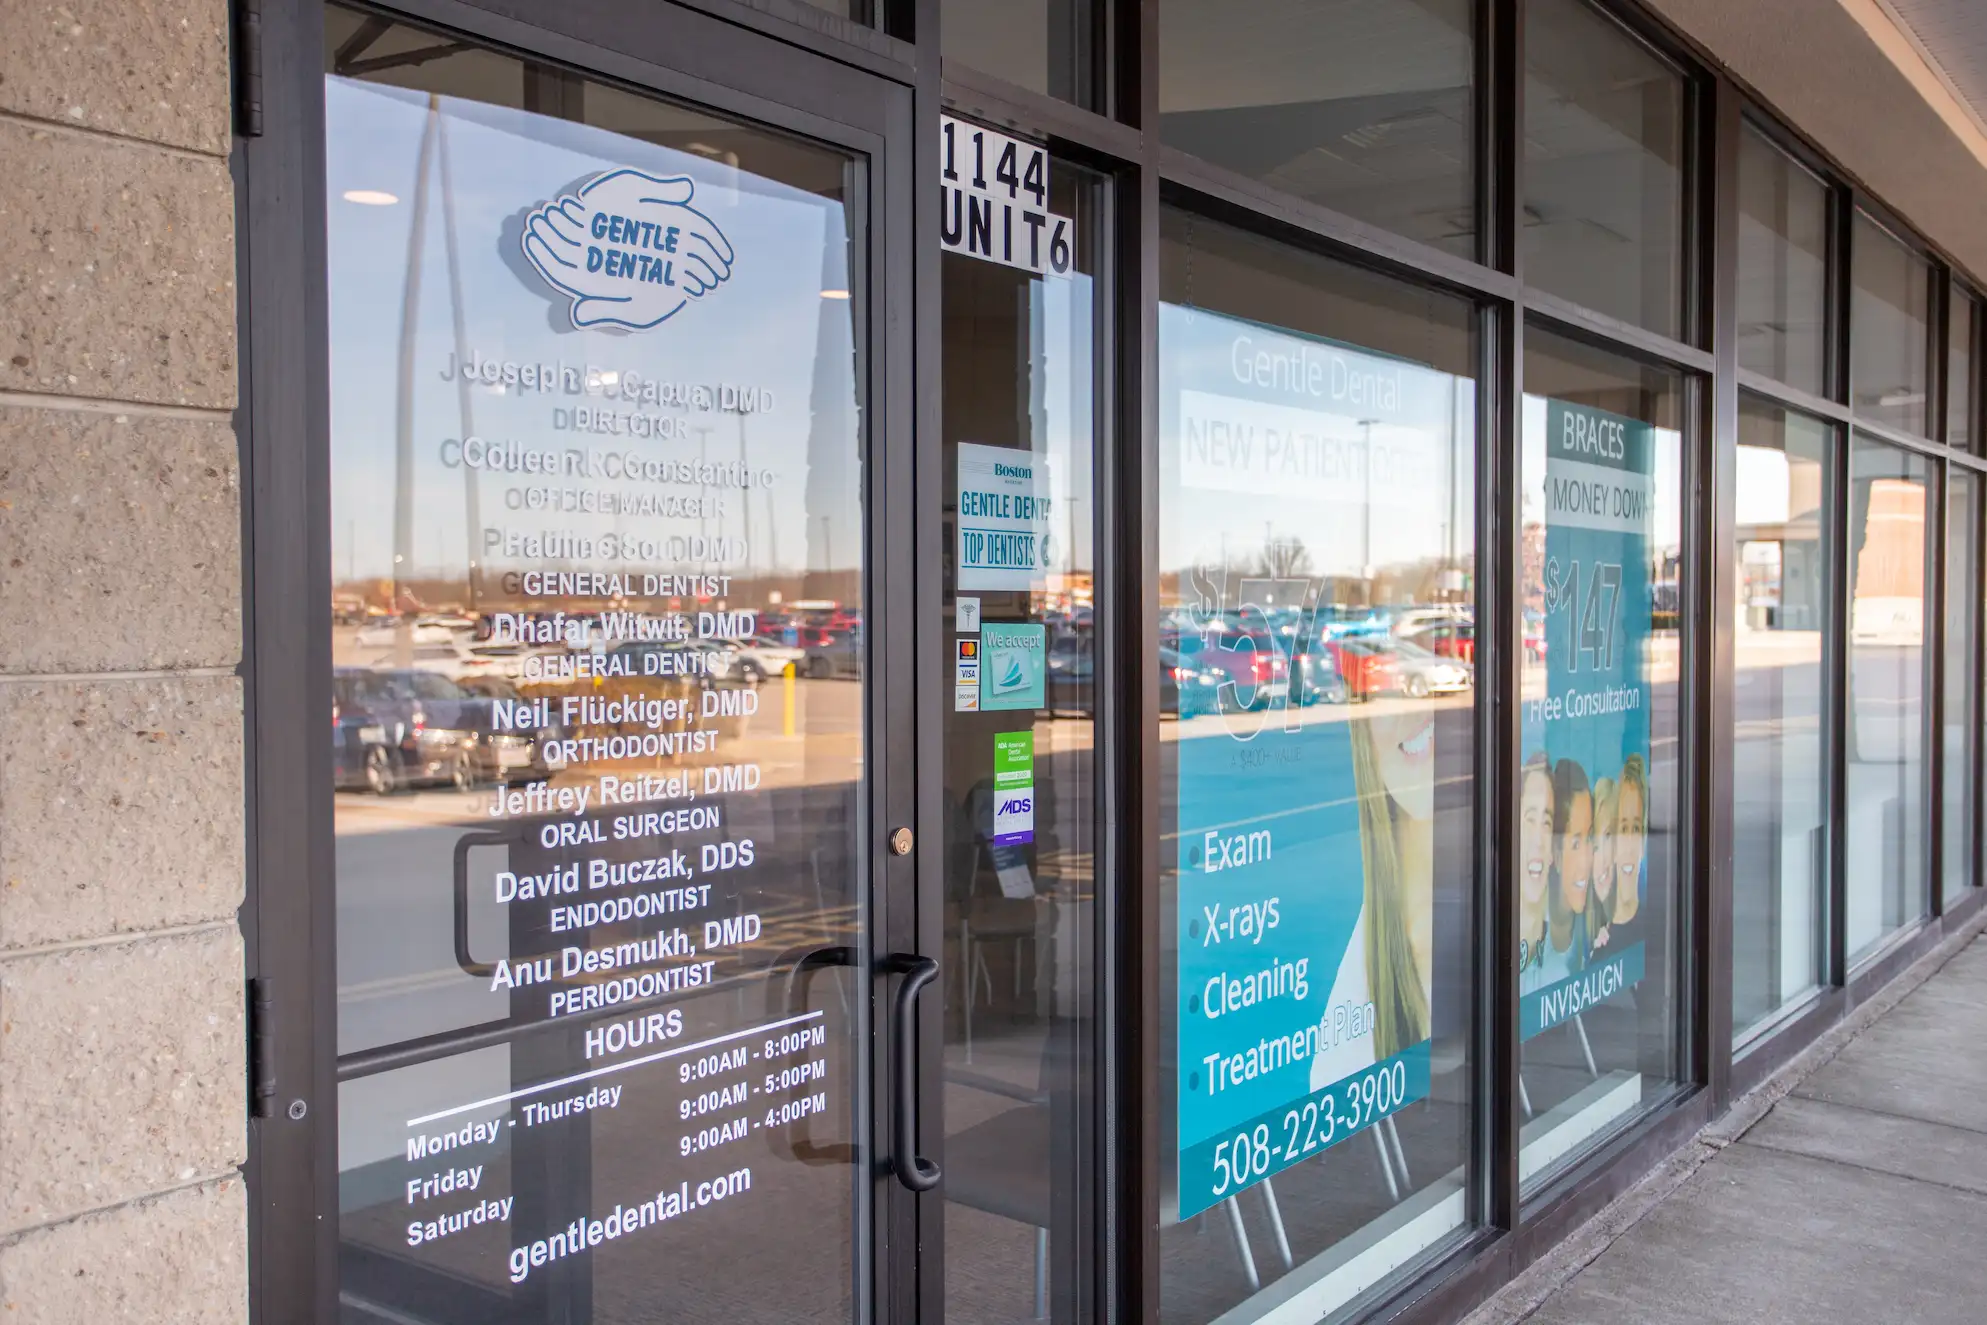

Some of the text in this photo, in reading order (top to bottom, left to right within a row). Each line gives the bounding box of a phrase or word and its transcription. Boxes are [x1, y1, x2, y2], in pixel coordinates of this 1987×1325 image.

[944, 122, 1046, 207] 1144
[591, 212, 681, 253] GENTLE
[586, 246, 676, 287] DENTAL
[462, 350, 576, 394] Joseph
[720, 382, 776, 414] DMD
[1232, 335, 1401, 413] Gentle Dental
[575, 404, 688, 438] DIRECTOR
[1186, 415, 1254, 472] NEW
[1563, 411, 1625, 461] BRACES
[994, 463, 1033, 479] Boston
[620, 492, 726, 520] MANAGER
[961, 490, 1052, 521] GENTLE DENTA
[1553, 477, 1610, 516] MONEY
[963, 532, 984, 564] TOP
[987, 533, 1037, 567] DENTISTS
[523, 570, 732, 597] GENERAL DENTIST
[494, 611, 756, 647] Dhafar Witwit, DMD
[986, 631, 1041, 652] We accept
[524, 650, 732, 681] GENERAL DENTIST
[961, 669, 976, 679] VISA
[492, 688, 759, 730] Neil Flückiger, DMD
[1530, 683, 1640, 723] Free Consultation
[543, 729, 719, 765] ORTHODONTIST
[489, 763, 761, 817] Jeffrey Reitzel, DMD
[998, 798, 1031, 816] MDS
[541, 805, 721, 850] ORAL SURGEON
[1203, 828, 1272, 874] Exam
[495, 838, 755, 904] David Buczak, DDS
[551, 883, 712, 933] ENDODONTIST
[1203, 895, 1280, 948] X-rays
[489, 913, 762, 992] Anu Desmukh, DMD
[551, 960, 716, 1018] PERIODONTIST
[1203, 957, 1309, 1020] Cleaning
[1540, 958, 1624, 1029] INVISALIGN
[585, 1009, 684, 1060] HOURS
[1203, 999, 1376, 1097] Treatment Plan
[407, 1025, 825, 1162] Monday - Thursday 9:00AM - 8:00PM
[407, 1058, 826, 1205] Friday 9:00AM - 5:00PM
[1211, 1060, 1406, 1197] 508-223-3900
[407, 1093, 826, 1248] Saturday 9:00AM - 4:00PM
[509, 1167, 752, 1284] gentledental.com
